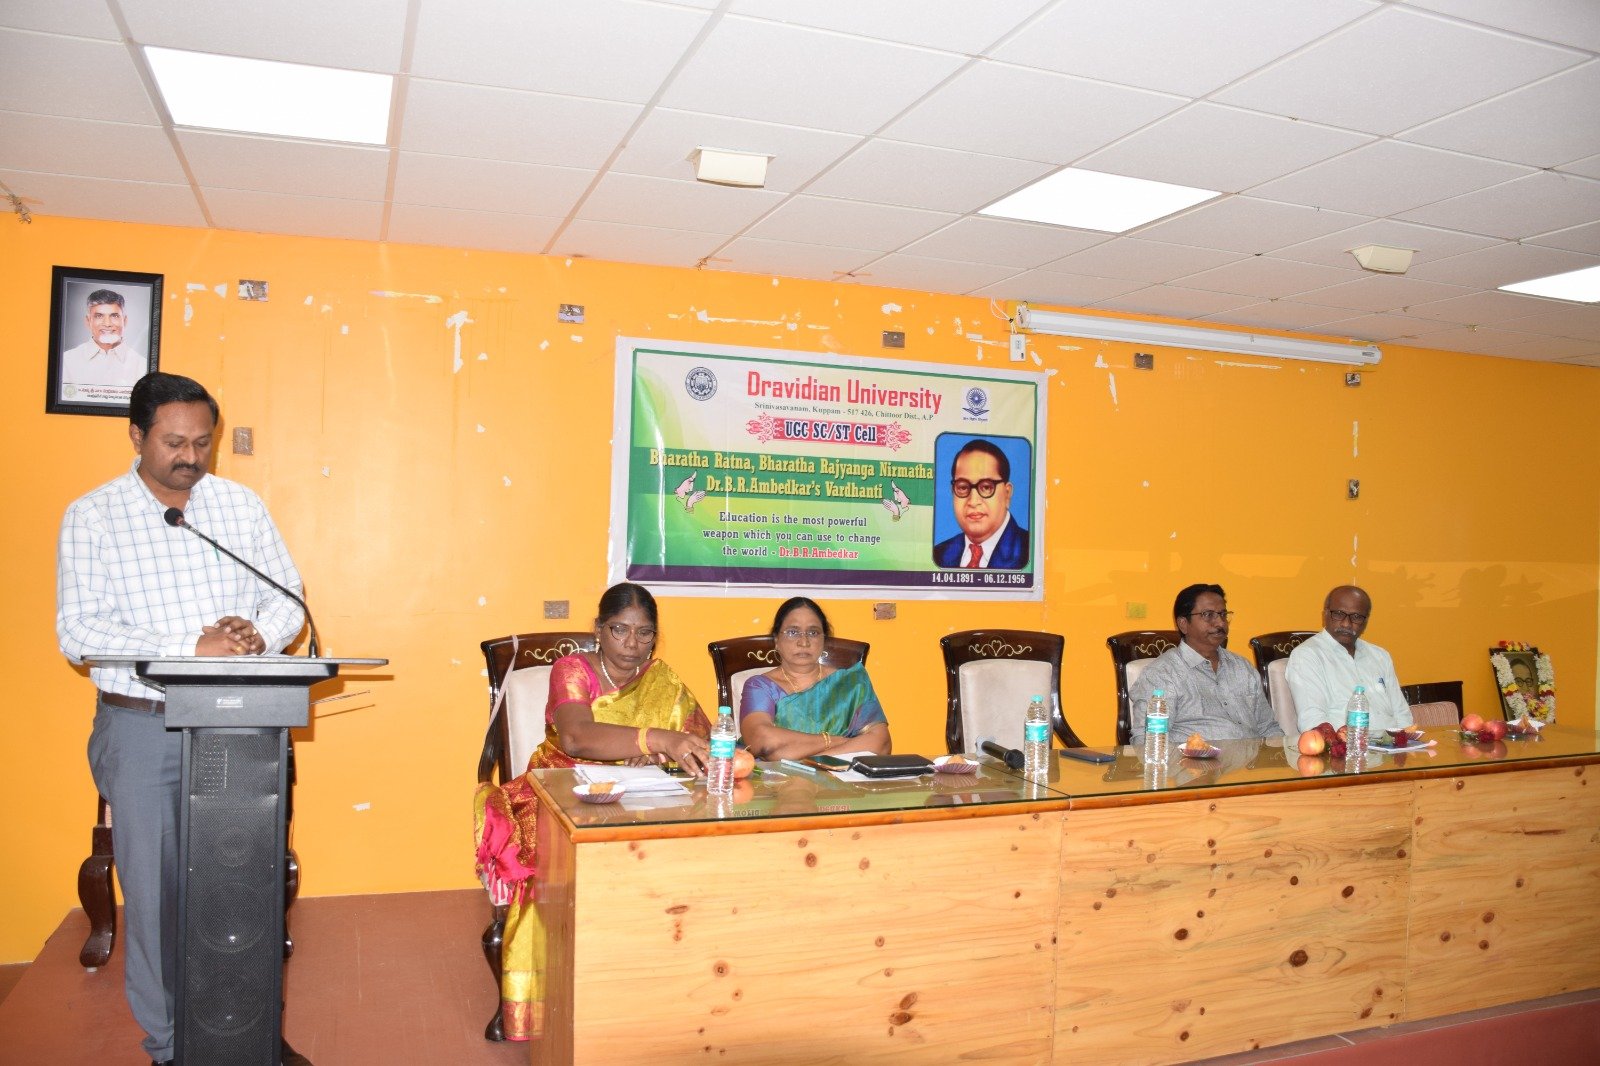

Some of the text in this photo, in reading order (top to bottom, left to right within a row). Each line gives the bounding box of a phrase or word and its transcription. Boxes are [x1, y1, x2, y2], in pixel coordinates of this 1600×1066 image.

[747, 371, 841, 402] Dravidian
[847, 379, 942, 414] University
[812, 406, 841, 416] Kuppam
[861, 409, 874, 417] 426,
[875, 410, 902, 418] Chittoor
[784, 420, 877, 442] UGC SC/ST Cell
[714, 452, 755, 473] Ratna,
[759, 454, 815, 473] Bharatha
[820, 458, 875, 480] Rajyanga
[879, 461, 934, 479] Nirmatha
[706, 475, 883, 499] Dr.B.R.Ambedkar's Vardhanti
[772, 513, 780, 524] is
[784, 514, 798, 524] the
[802, 515, 825, 525] most
[828, 516, 867, 528] powerful
[702, 529, 881, 545] weapon which you can use to change
[722, 546, 738, 556] the
[741, 546, 767, 556] world
[779, 547, 859, 559] Dr.B.R.Ambedkar
[932, 572, 974, 583] 14.04.1891
[984, 573, 1026, 584] 06.12.1956
